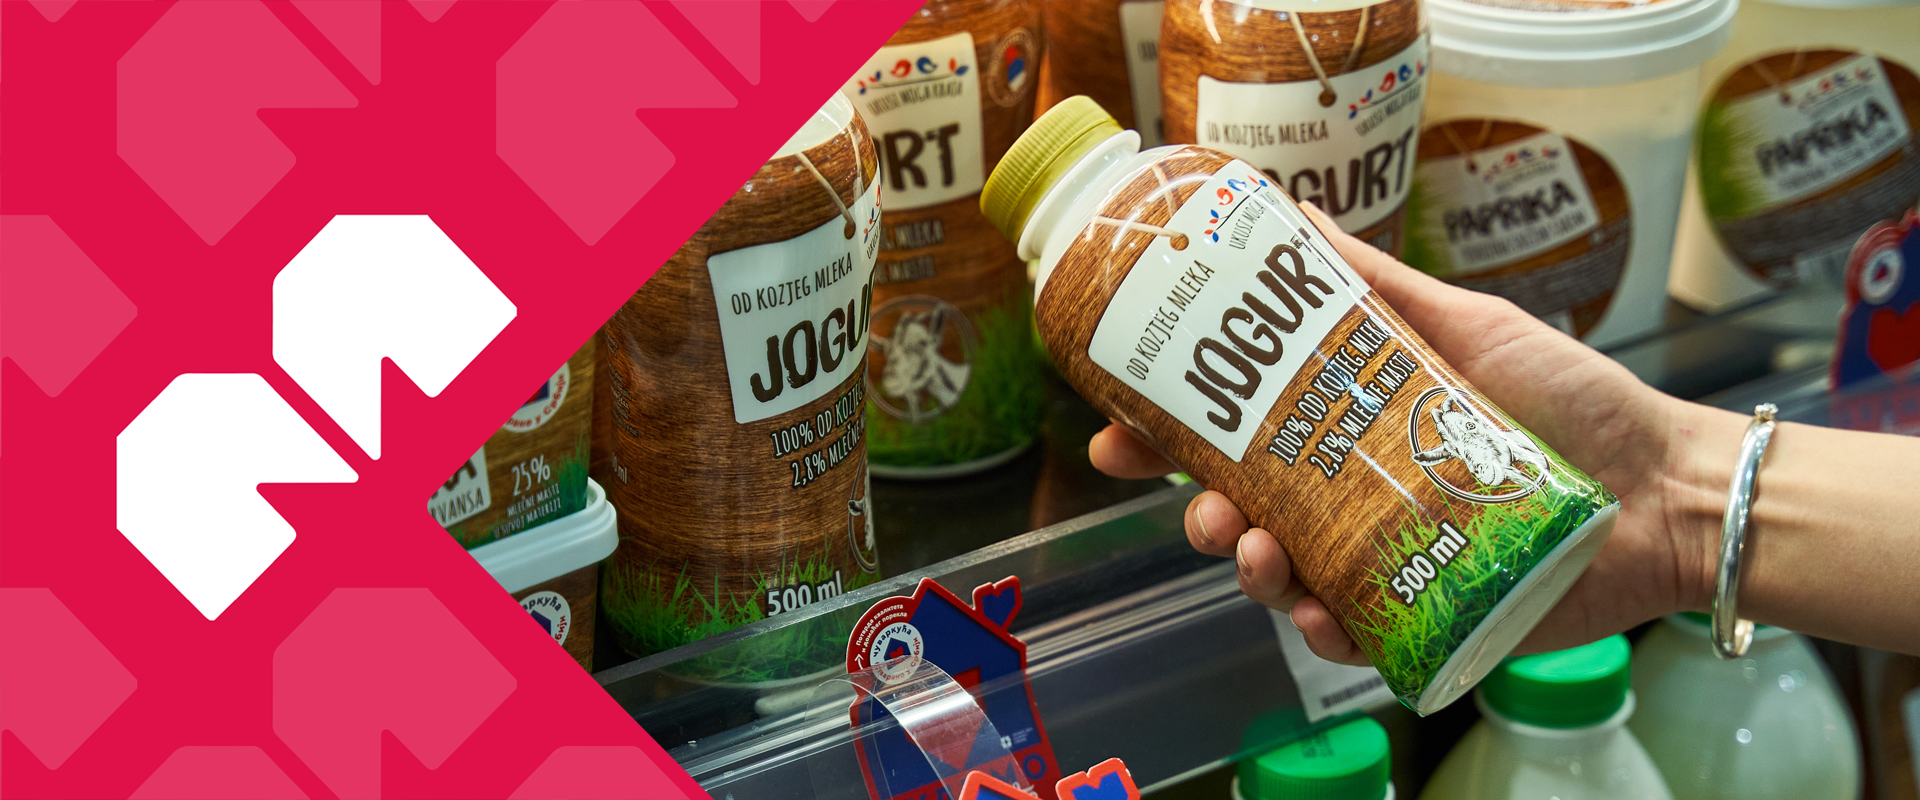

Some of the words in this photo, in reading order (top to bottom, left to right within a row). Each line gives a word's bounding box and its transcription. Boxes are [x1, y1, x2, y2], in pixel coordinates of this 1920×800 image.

[1223, 124, 1274, 148] KOZJEG
[1278, 119, 1329, 146] MLEKA
[1443, 180, 1577, 241] PAPRIKA
[731, 292, 752, 315] OD
[756, 275, 811, 311] KOZJEG
[815, 252, 852, 292] MLEKA
[1166, 259, 1215, 312] MLEKA
[1135, 306, 1180, 362] KOZJEG
[1126, 357, 1149, 380] OD
[1269, 415, 1313, 464] 100%
[1298, 393, 1328, 421] OD
[1314, 347, 1366, 401] KOZJEG
[1349, 314, 1392, 354] MLEKA
[772, 421, 814, 456] 100%
[816, 410, 832, 438] OD
[1310, 431, 1354, 477] 2,8%
[1376, 350, 1417, 393] MASTI
[511, 454, 550, 497] 25%
[792, 451, 826, 486] 2,8%
[828, 420, 860, 467] MLEČNE
[507, 496, 535, 518] MLEČNE
[537, 483, 560, 504] MASTI
[527, 497, 561, 524] MATERIJI
[1391, 554, 1436, 604] 500
[1429, 522, 1467, 565] ml
[768, 584, 812, 617] 500
[817, 570, 843, 601] ml
[856, 618, 874, 646] Потврда
[873, 604, 904, 620] квалитета
[863, 620, 881, 648] домаћег
[881, 611, 908, 623] порекла
[873, 624, 912, 657] чуваркућа
